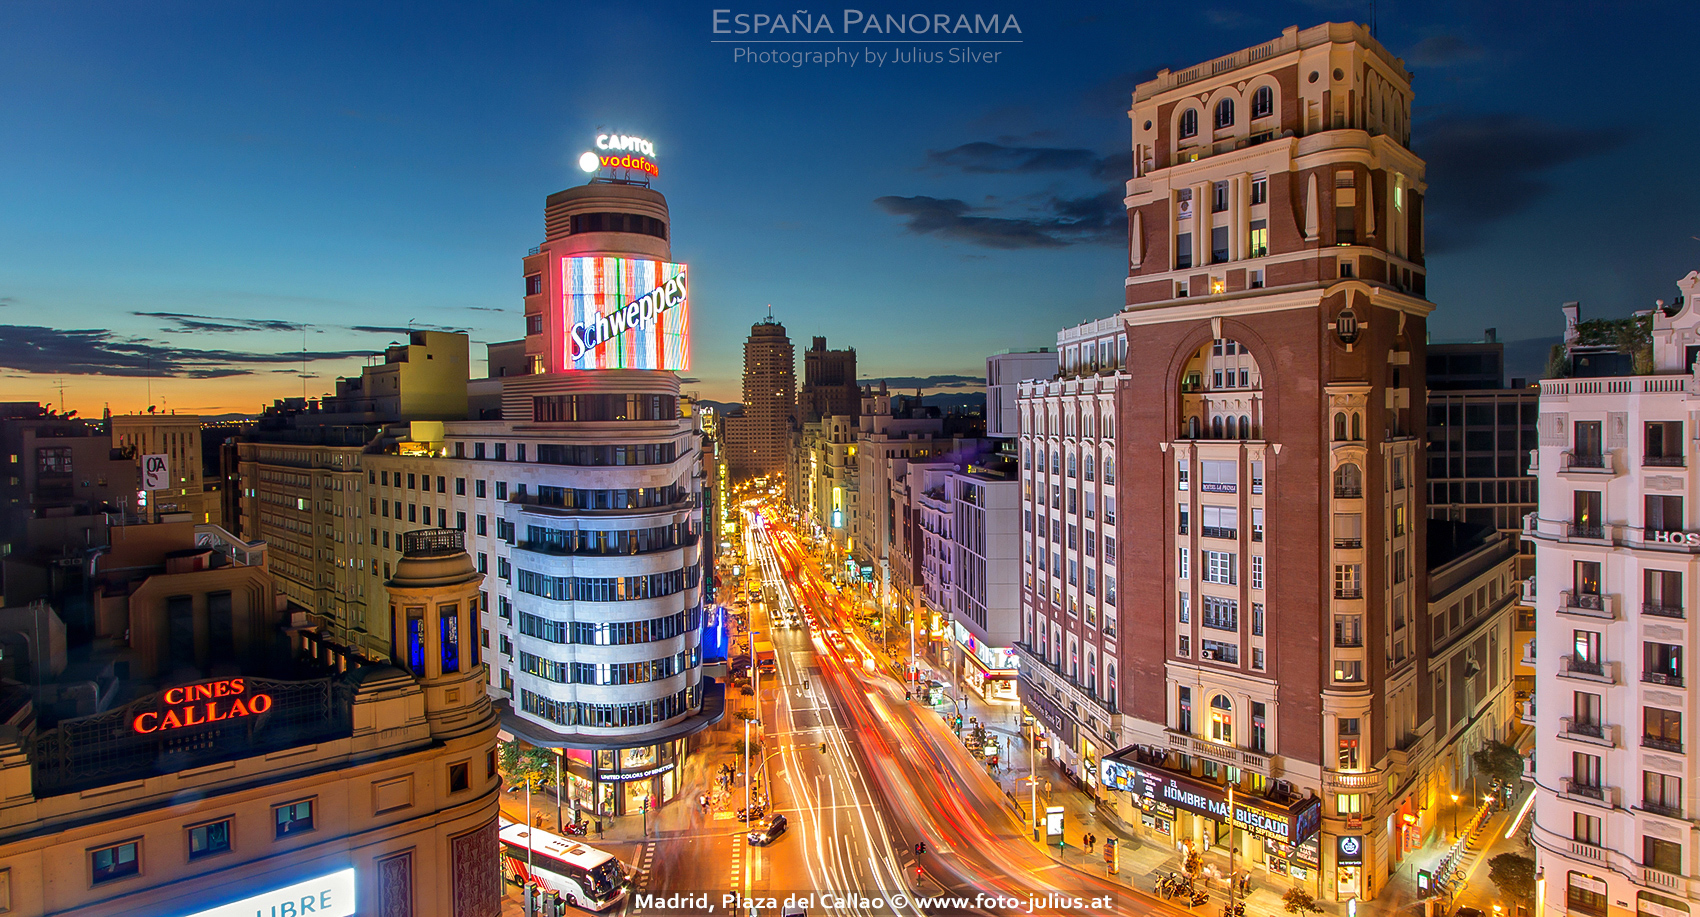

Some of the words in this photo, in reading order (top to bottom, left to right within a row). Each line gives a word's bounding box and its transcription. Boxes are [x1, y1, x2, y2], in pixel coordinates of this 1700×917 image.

[597, 134, 656, 158] CAPITOL
[571, 271, 687, 361] Schweppes
[164, 678, 245, 705] CINES
[133, 694, 272, 734] CALLAO
[1163, 785, 1207, 810] HOMBRE
[1236, 808, 1289, 837] BUSCADO
